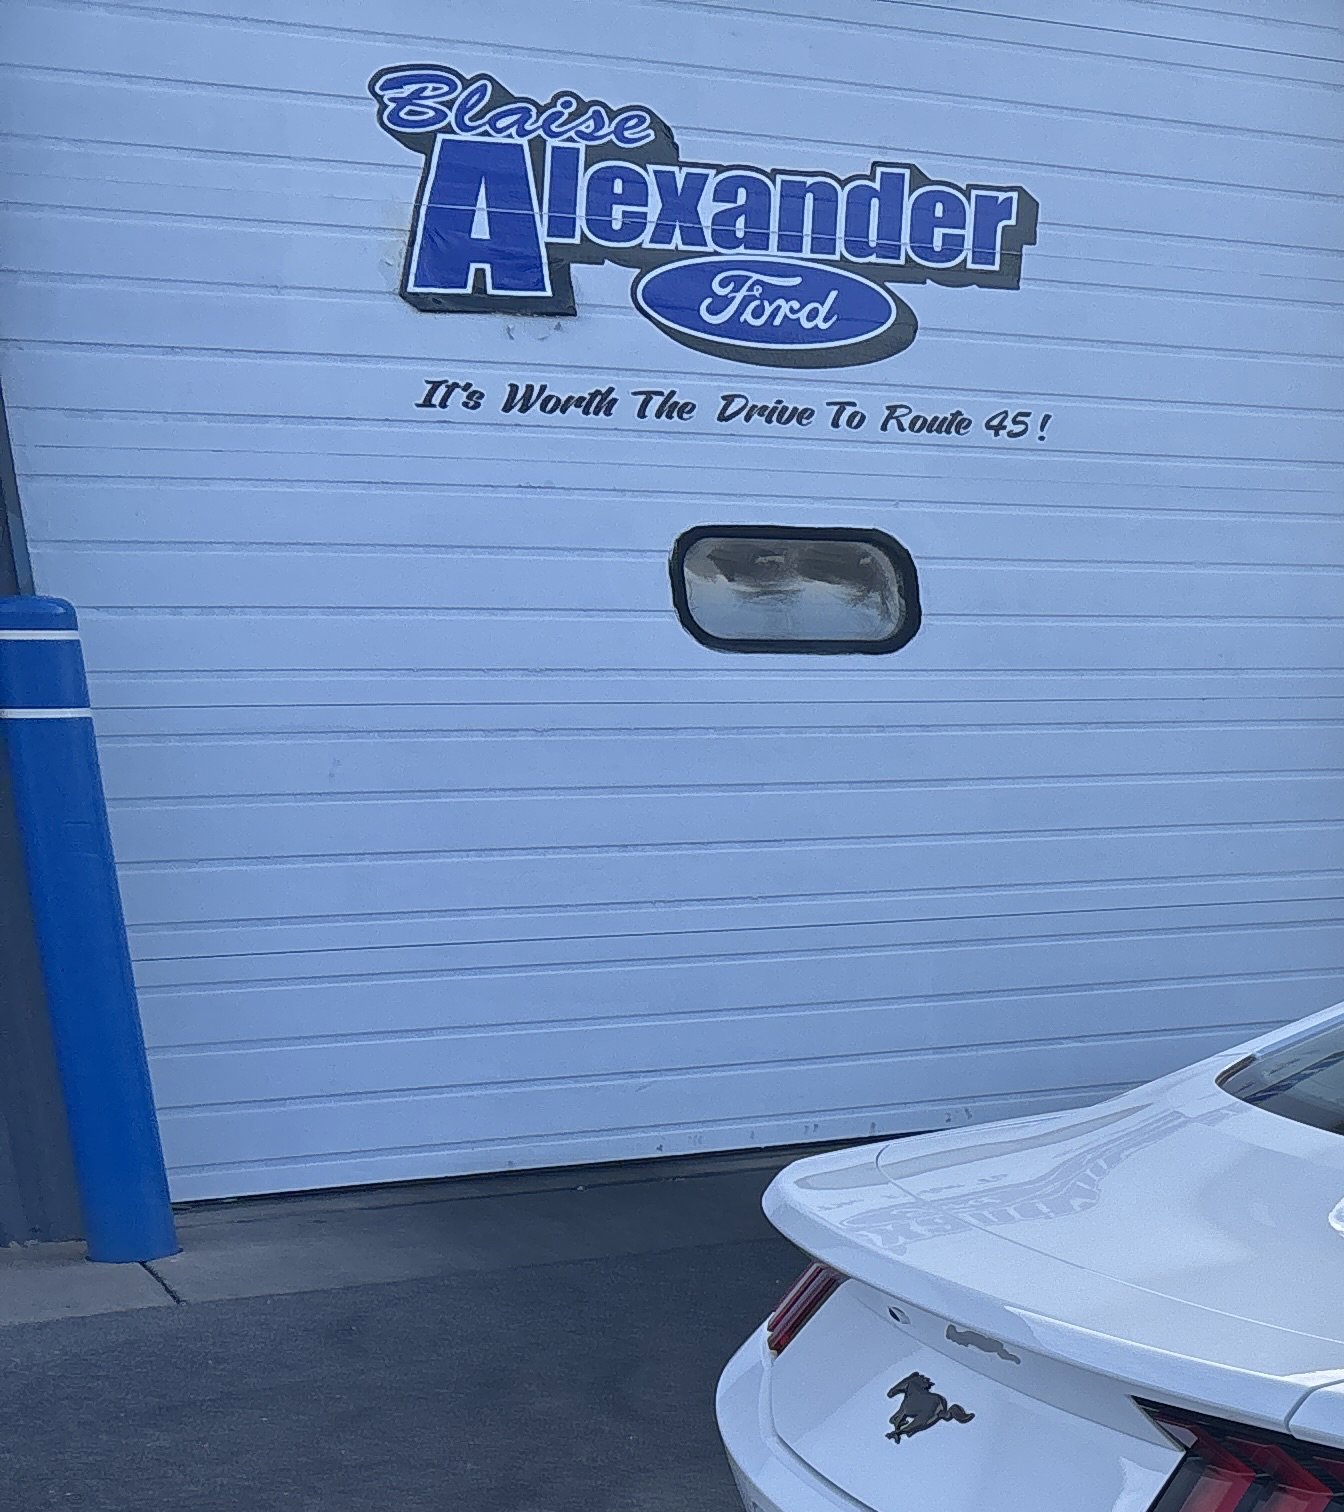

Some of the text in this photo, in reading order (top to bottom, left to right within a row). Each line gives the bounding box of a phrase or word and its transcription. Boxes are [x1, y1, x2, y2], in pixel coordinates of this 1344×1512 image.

[374, 68, 658, 150] Blaise
[406, 134, 1019, 298] Alexander
[698, 268, 839, 332] Ford
[415, 378, 484, 413] It's
[499, 382, 618, 421] Worth
[629, 389, 697, 422] The
[715, 392, 816, 430] Drive
[825, 400, 867, 432] To
[879, 403, 972, 439] Route
